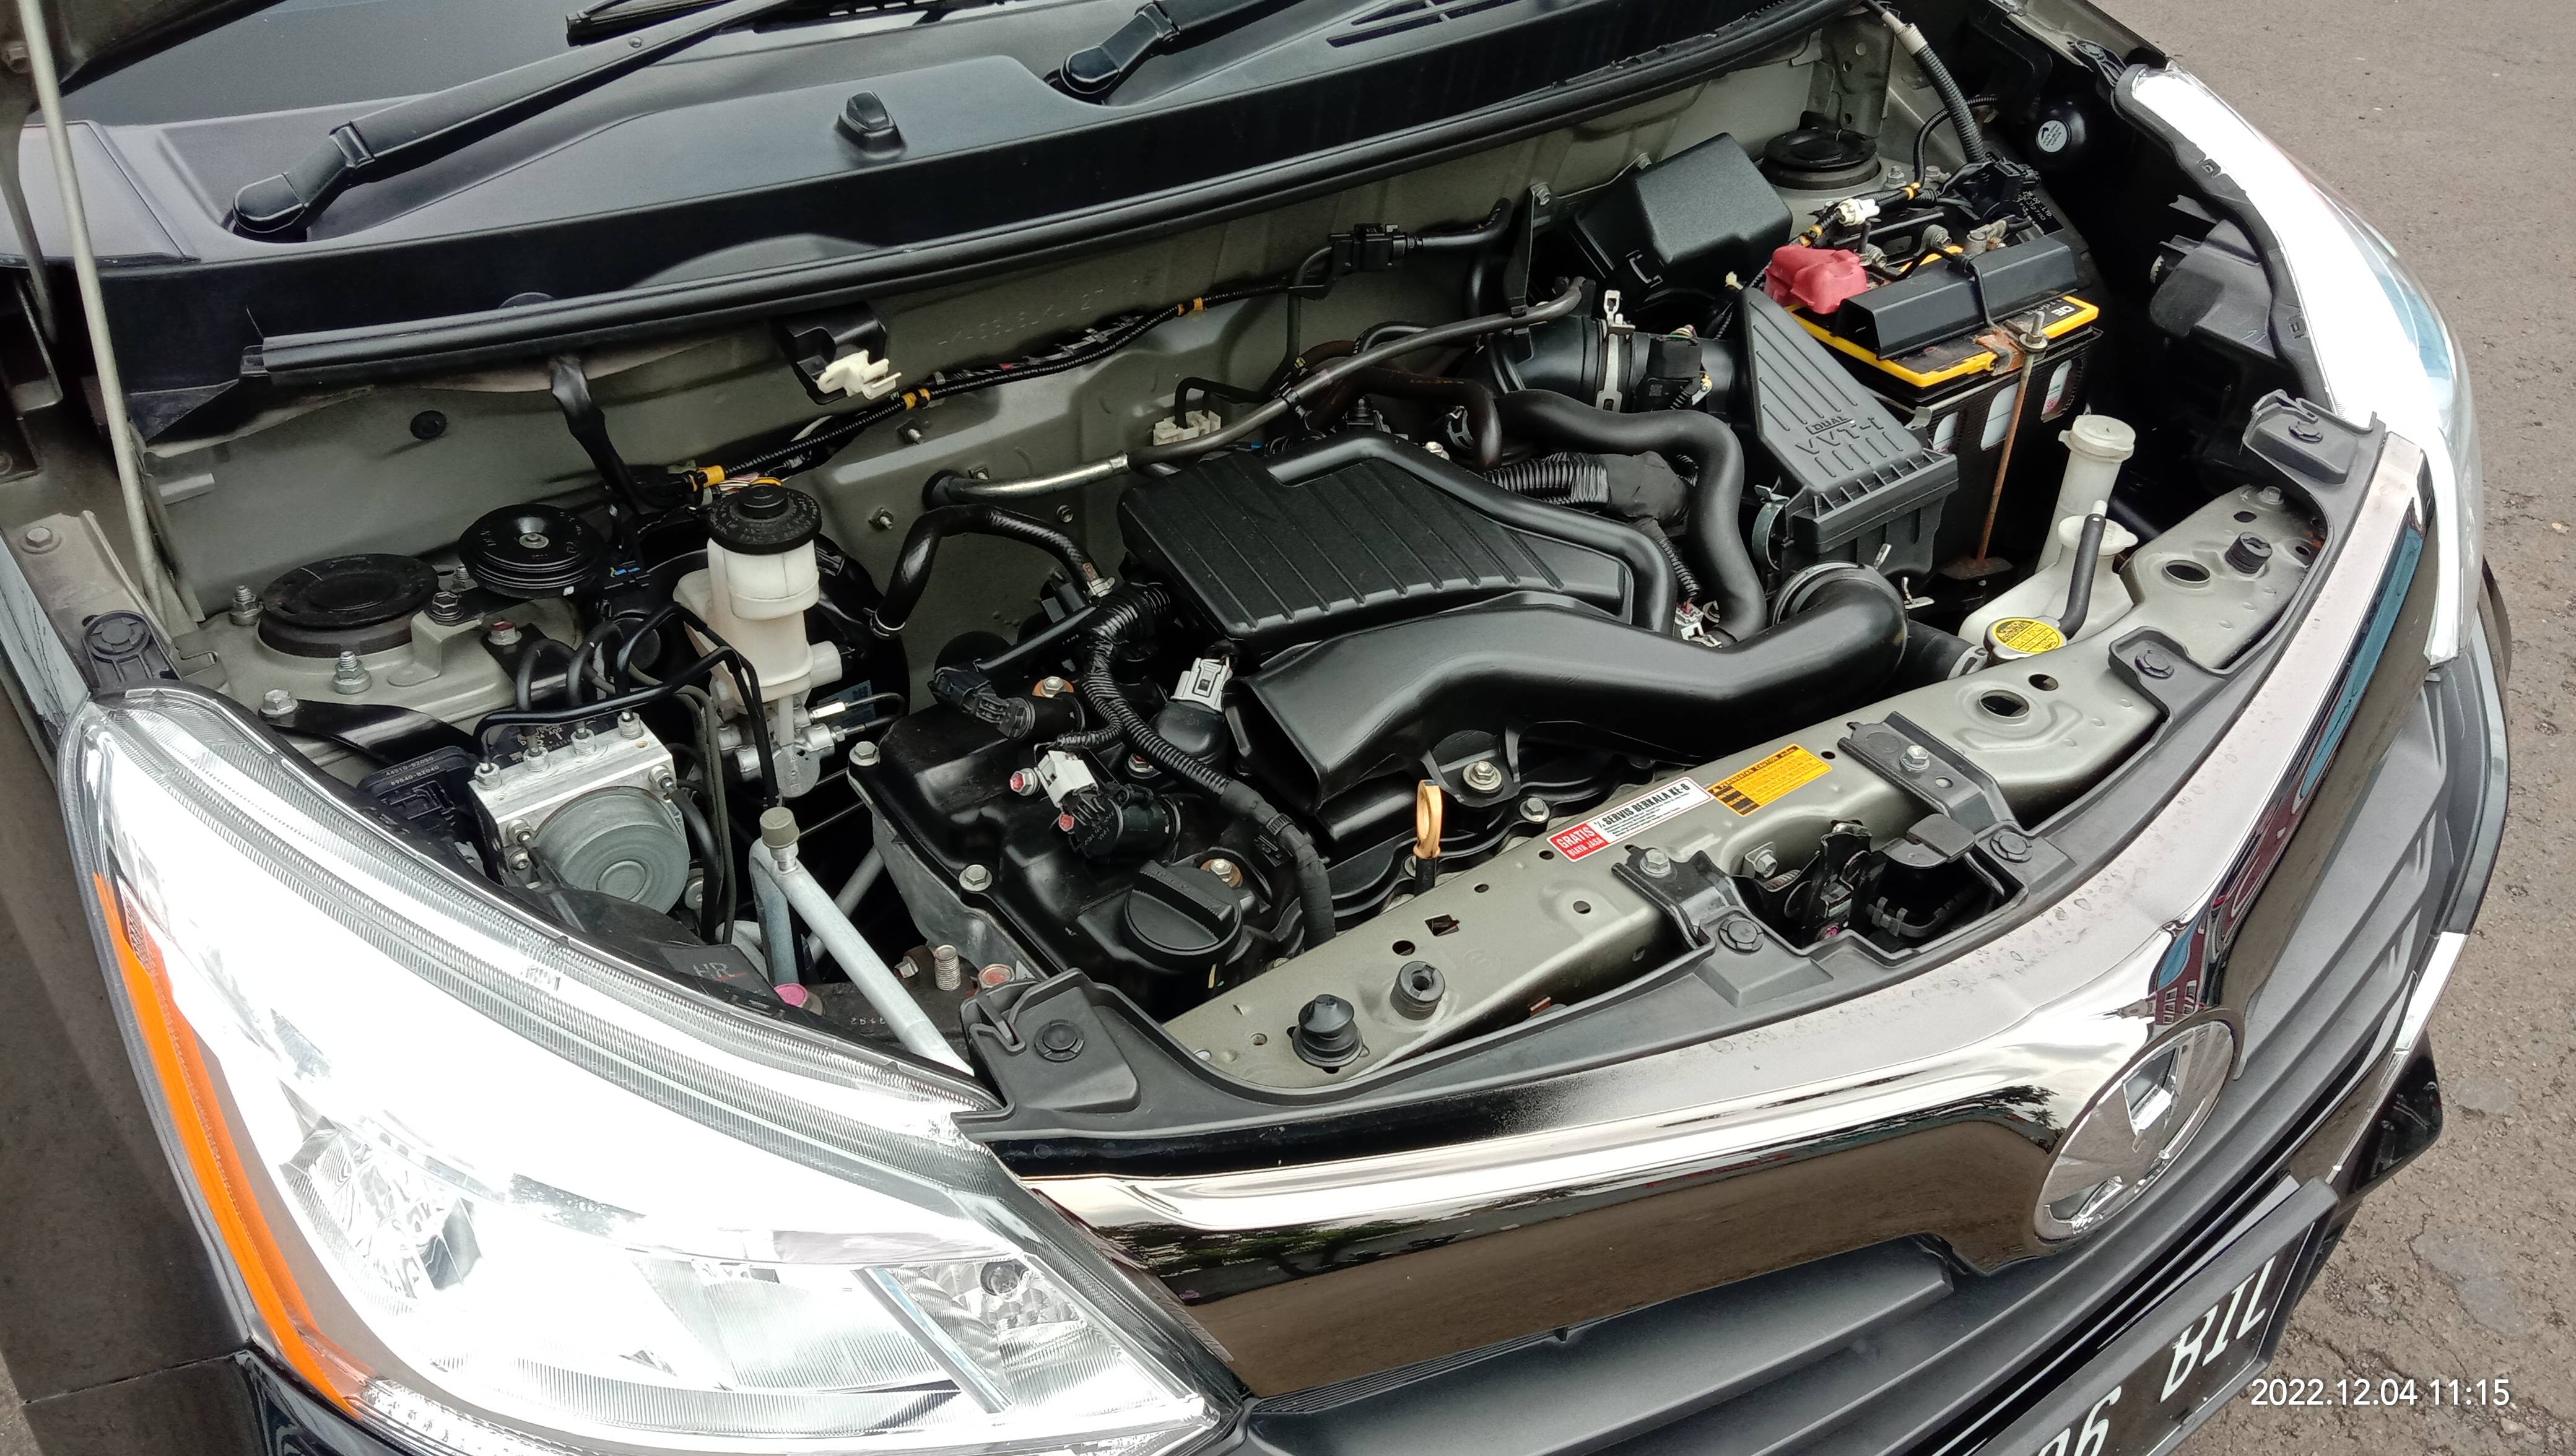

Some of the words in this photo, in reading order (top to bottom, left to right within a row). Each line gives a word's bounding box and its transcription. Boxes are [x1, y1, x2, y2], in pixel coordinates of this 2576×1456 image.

[1811, 416, 1848, 430] DUAL
[1720, 769, 1754, 788] PERINGATAN
[1755, 756, 1778, 770] CAUTION
[1602, 807, 1635, 825] SERVIS
[1631, 792, 1672, 812] BERKALA
[1668, 782, 1690, 796] KE-6
[1556, 826, 1595, 849] GRATIS
[1567, 842, 1587, 857] BIAYA
[1587, 836, 1604, 851] JASA
[2159, 1255, 2277, 1403] BIL
